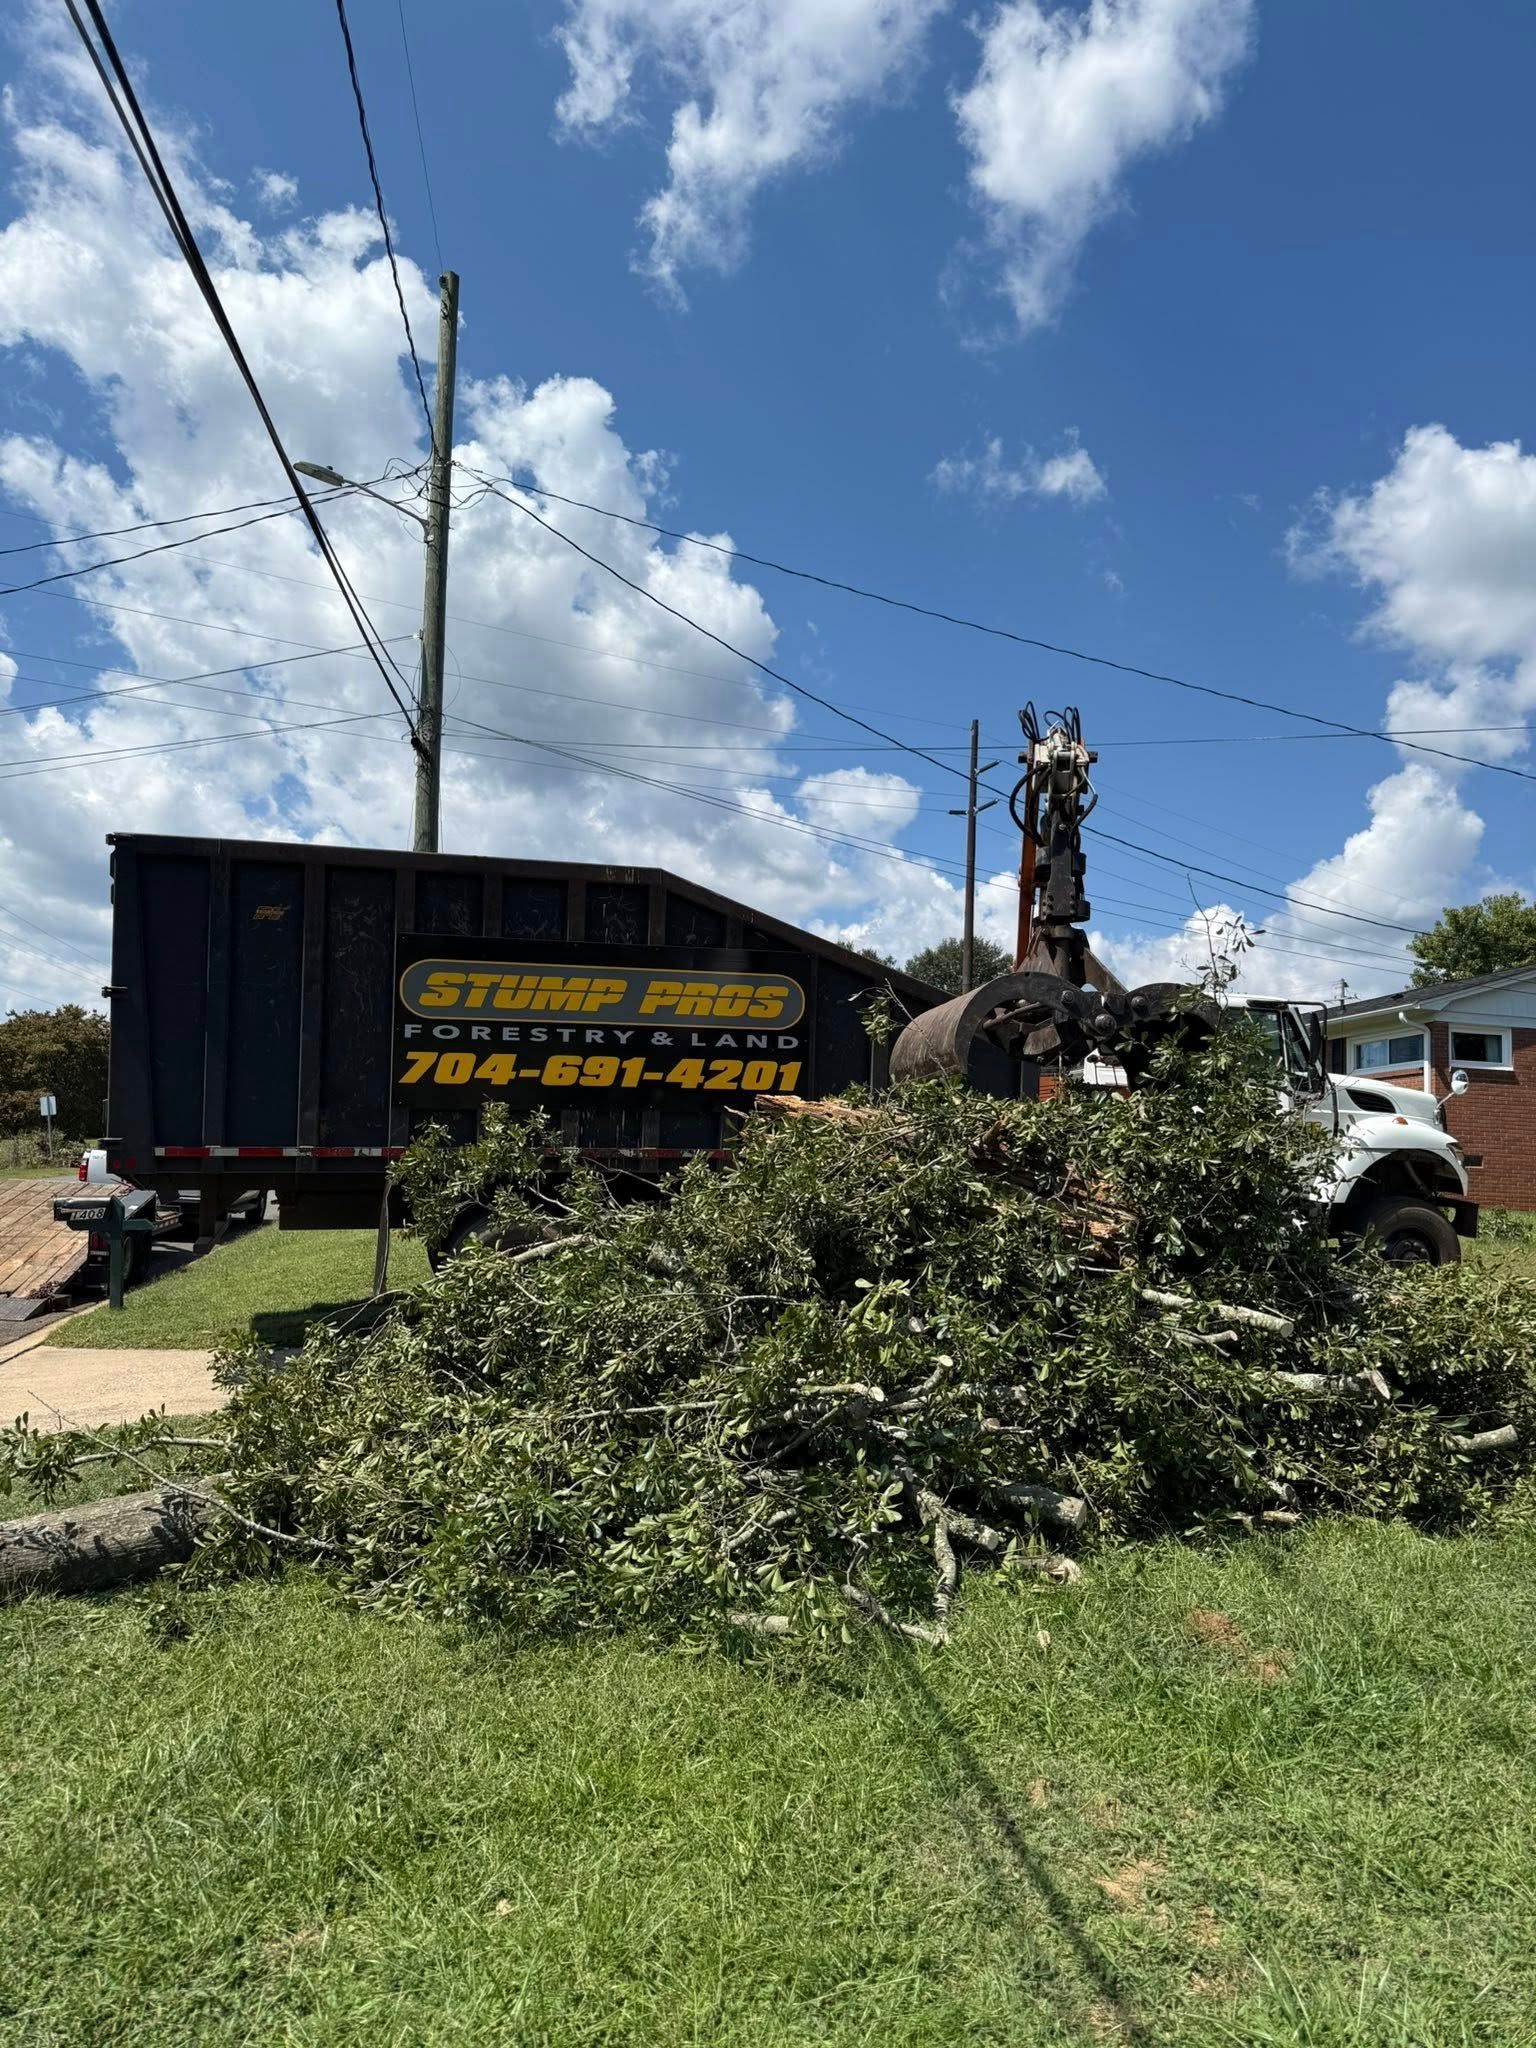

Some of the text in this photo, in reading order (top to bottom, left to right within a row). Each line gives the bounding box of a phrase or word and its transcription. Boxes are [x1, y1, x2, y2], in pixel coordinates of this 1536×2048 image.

[418, 971, 790, 1019] STUMP PROS
[404, 1024, 800, 1050] FORESTRY & LAND
[398, 1051, 802, 1092] 704-691-4201
